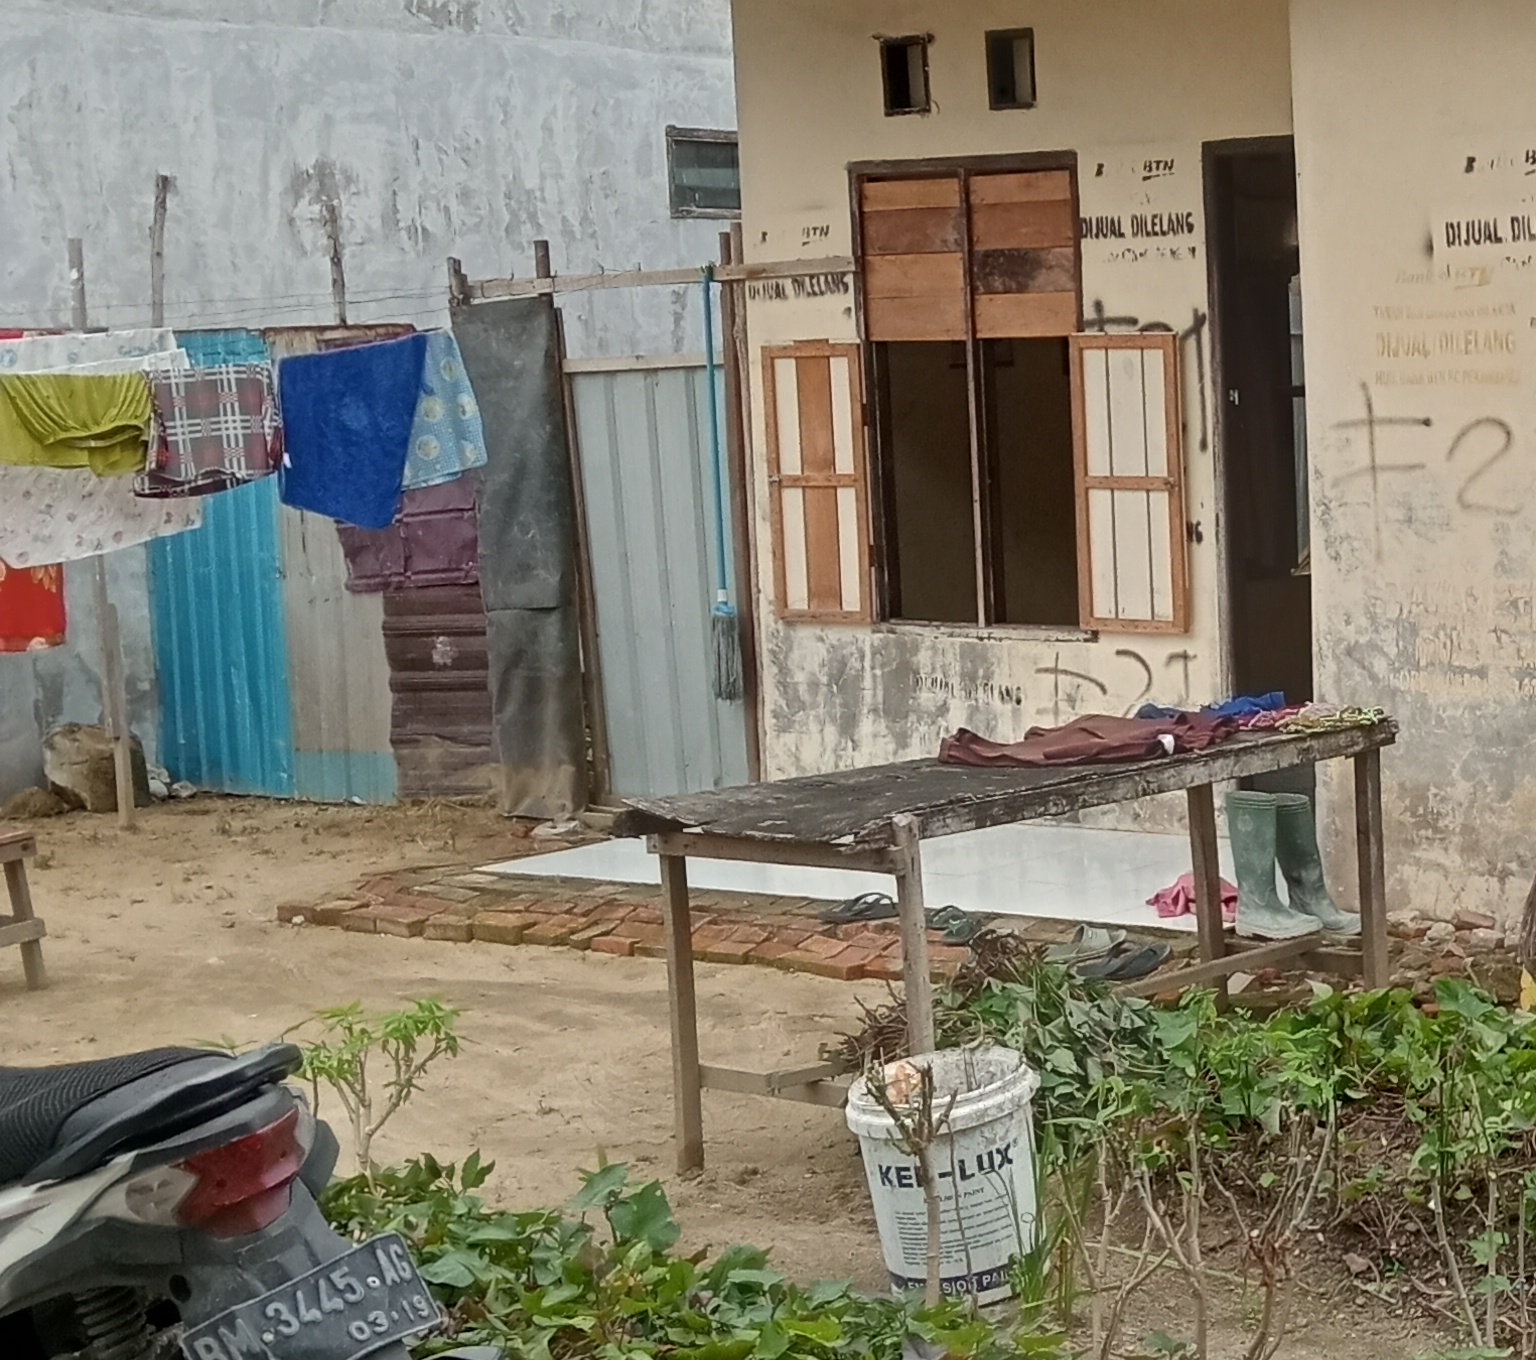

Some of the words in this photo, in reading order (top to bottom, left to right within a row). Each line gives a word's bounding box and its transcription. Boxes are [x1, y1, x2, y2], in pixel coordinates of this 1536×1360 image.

[1142, 158, 1175, 174] BTN
[1080, 214, 1126, 240] DIJUAL
[1131, 211, 1195, 238] DILELANG
[1445, 217, 1504, 248] DIJUAL
[265, 1265, 366, 1337] 3445
